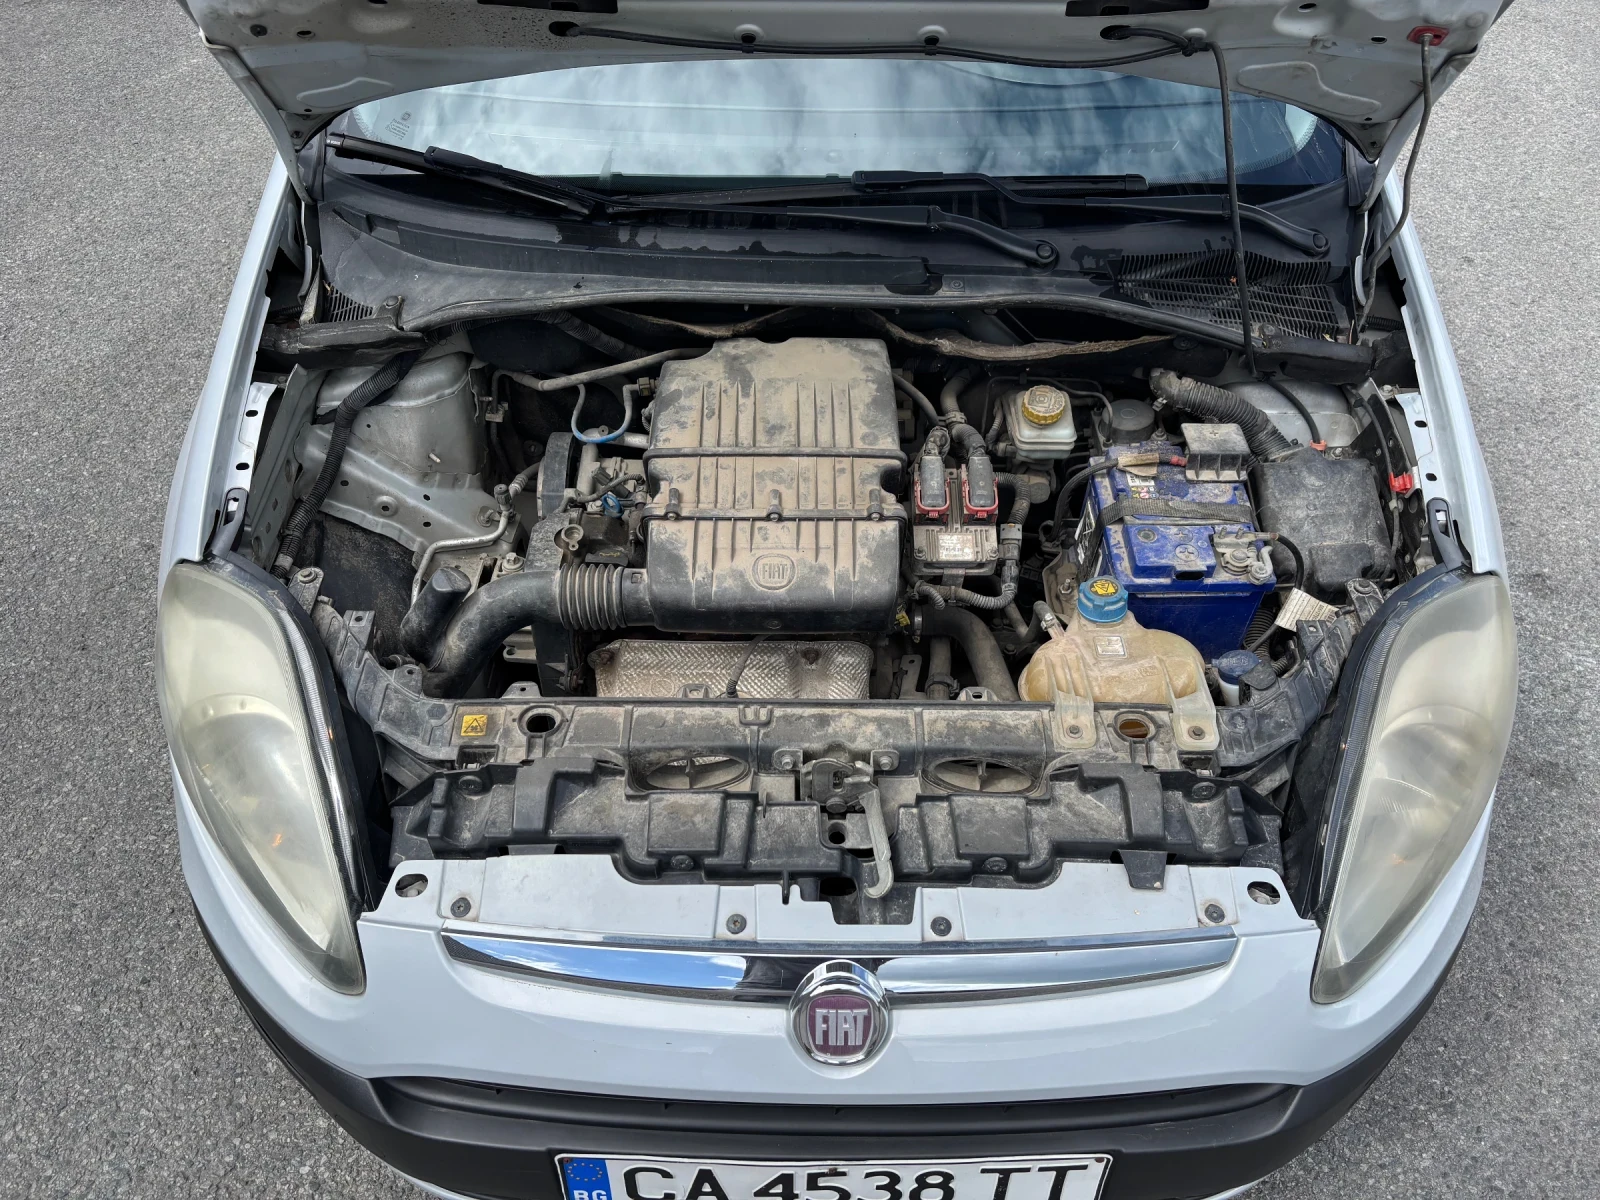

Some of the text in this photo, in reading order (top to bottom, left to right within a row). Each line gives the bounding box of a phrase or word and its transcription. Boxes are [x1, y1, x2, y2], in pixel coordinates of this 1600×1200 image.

[762, 562, 788, 580] FIAT
[815, 1008, 868, 1046] FIAT
[573, 1190, 607, 1200] BG
[623, 1163, 1089, 1200] CA 4538 TT
